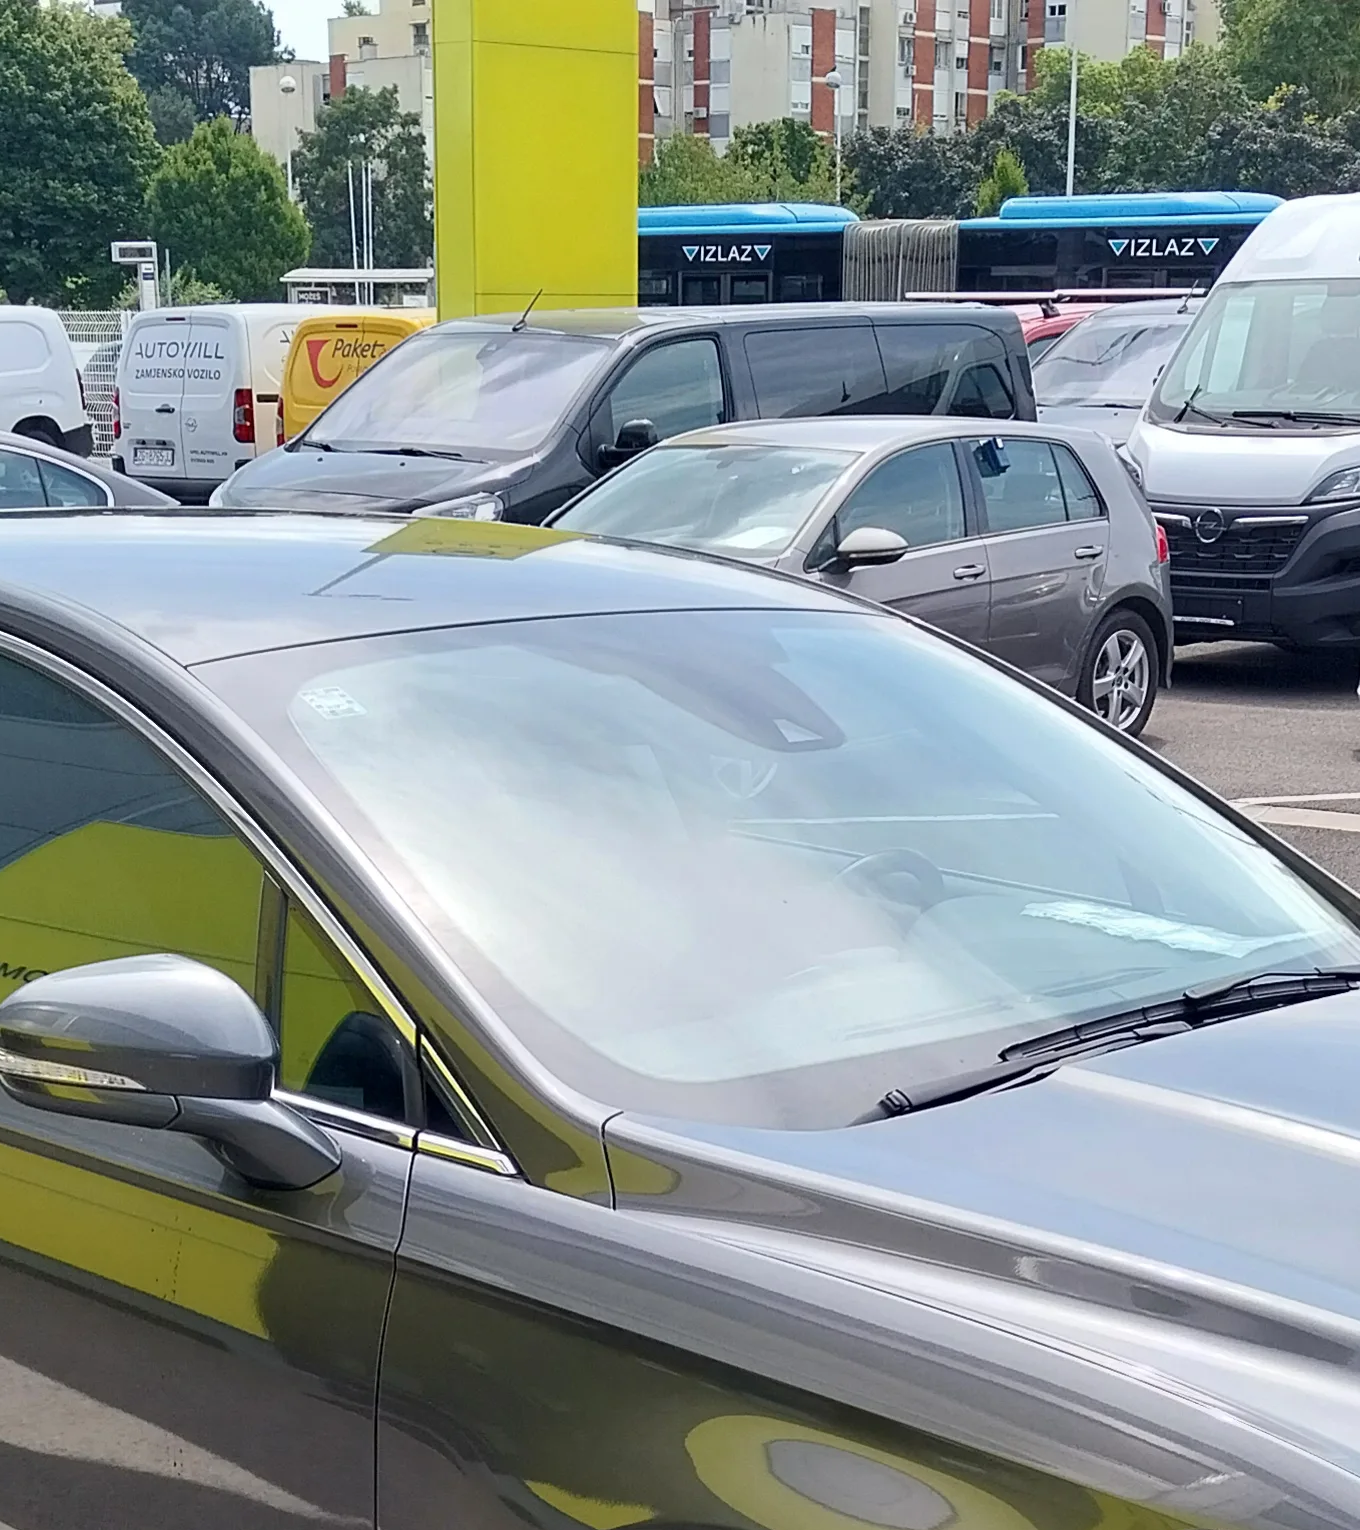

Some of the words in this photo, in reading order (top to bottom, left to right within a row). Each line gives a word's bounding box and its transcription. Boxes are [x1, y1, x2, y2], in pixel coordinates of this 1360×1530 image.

[700, 245, 752, 262] IZLAZ
[1130, 238, 1195, 257] IZLAZ
[135, 341, 224, 360] AUTOWILL
[135, 367, 185, 379] ZAMJENSKO
[187, 368, 221, 381] VOZILO
